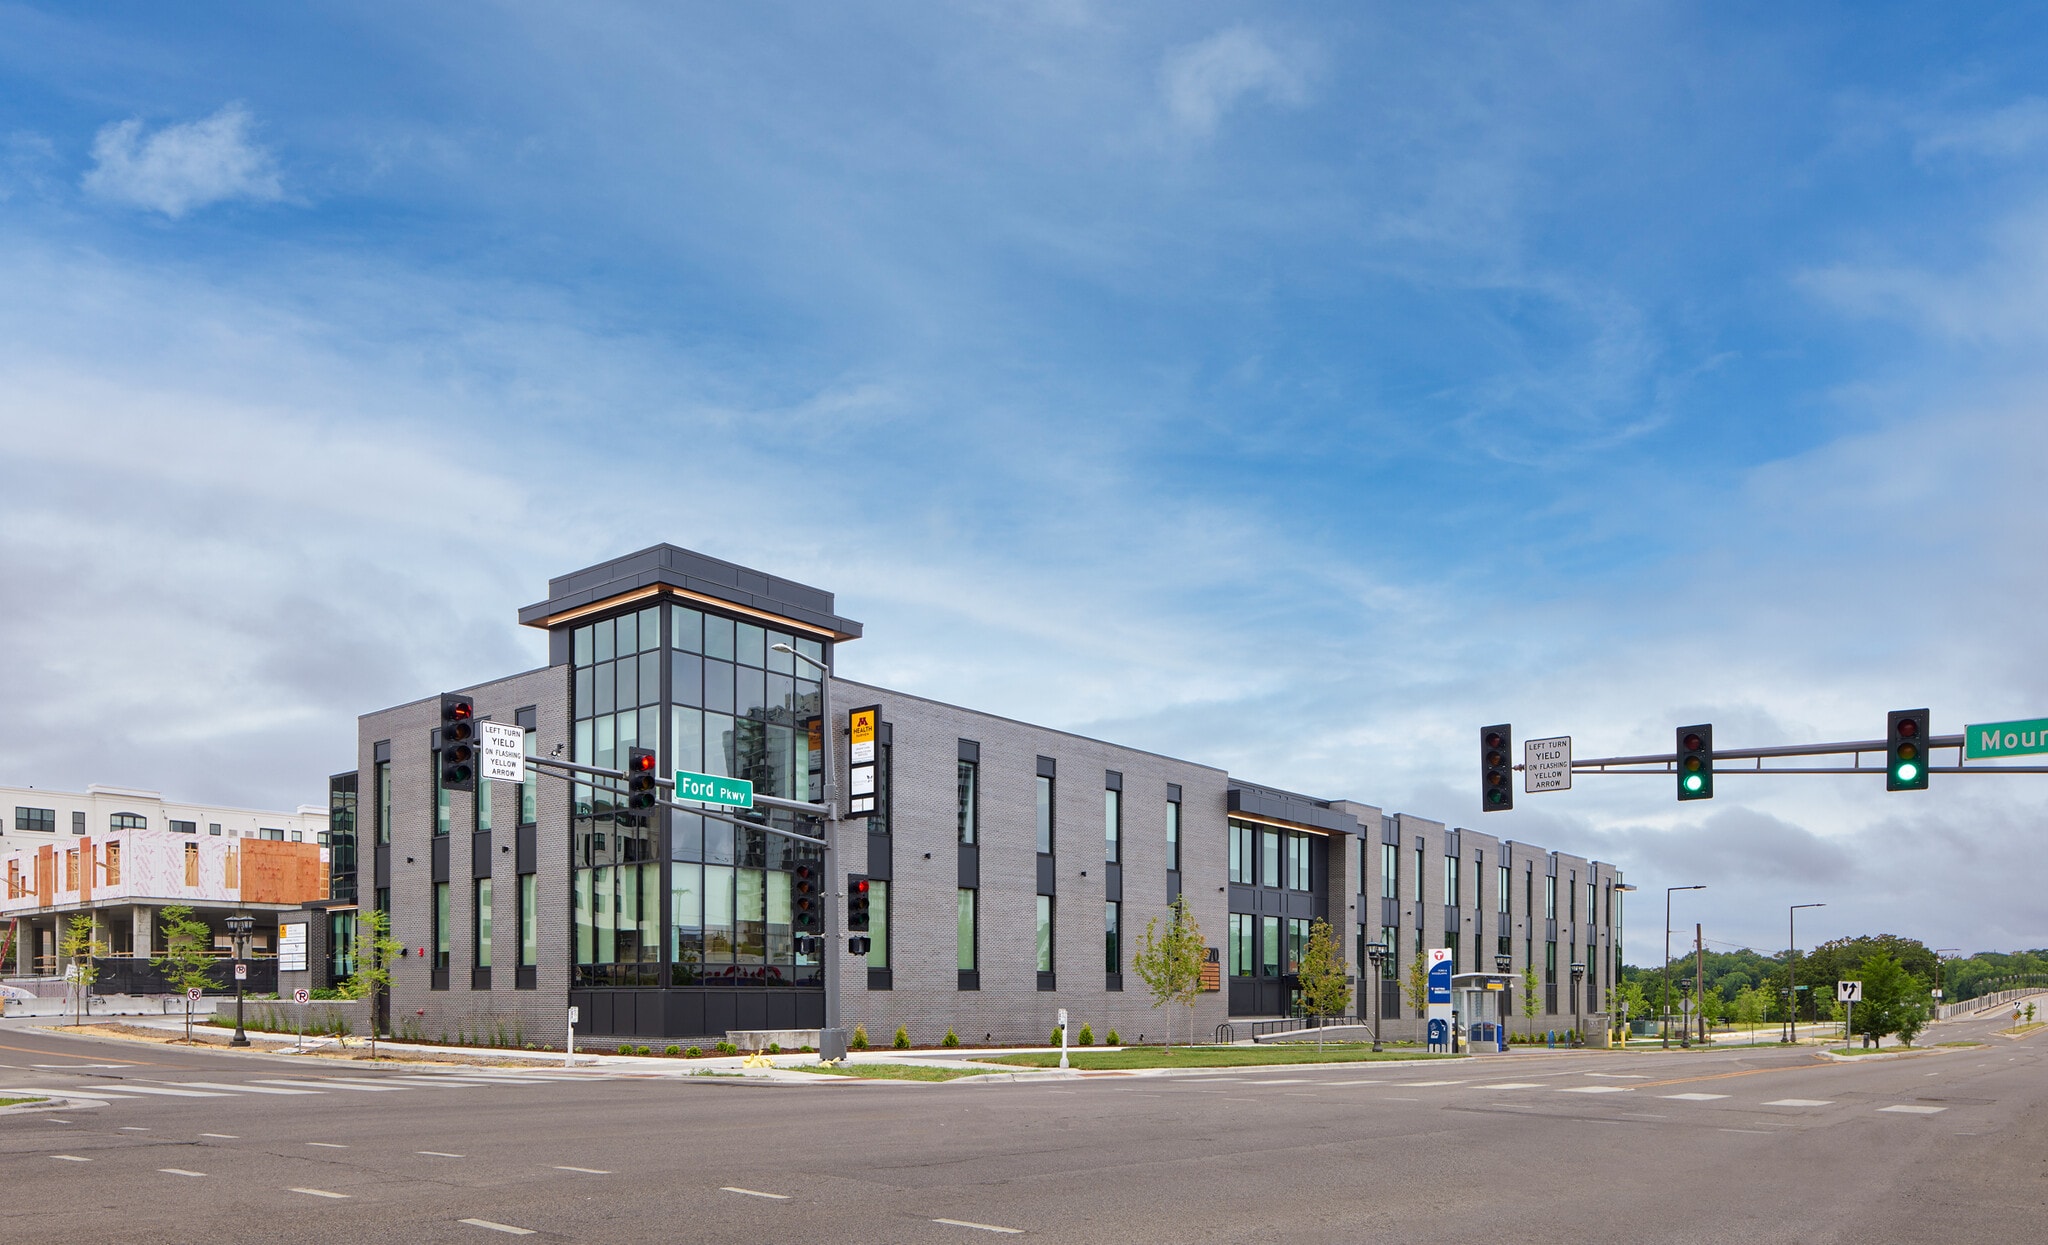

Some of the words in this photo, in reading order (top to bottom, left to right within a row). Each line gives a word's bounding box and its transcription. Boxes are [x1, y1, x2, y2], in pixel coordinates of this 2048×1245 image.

[485, 726, 500, 734] LEFT
[504, 729, 521, 737] TURN
[853, 725, 873, 734] HEALTH
[491, 737, 515, 748] YIELD
[1528, 742, 1545, 751] LEFT
[1548, 740, 1567, 748] TURN
[485, 747, 493, 755] ON
[495, 749, 521, 760] FLASHING
[1535, 751, 1561, 761] YIELD
[490, 758, 517, 768] YELLOW
[1539, 760, 1568, 770] FLASHING
[491, 768, 515, 777] ARROW
[1534, 770, 1562, 779] YELLOW
[1535, 780, 1561, 789] ARROW
[682, 777, 714, 798] Ford
[720, 787, 746, 805] Pkwy
